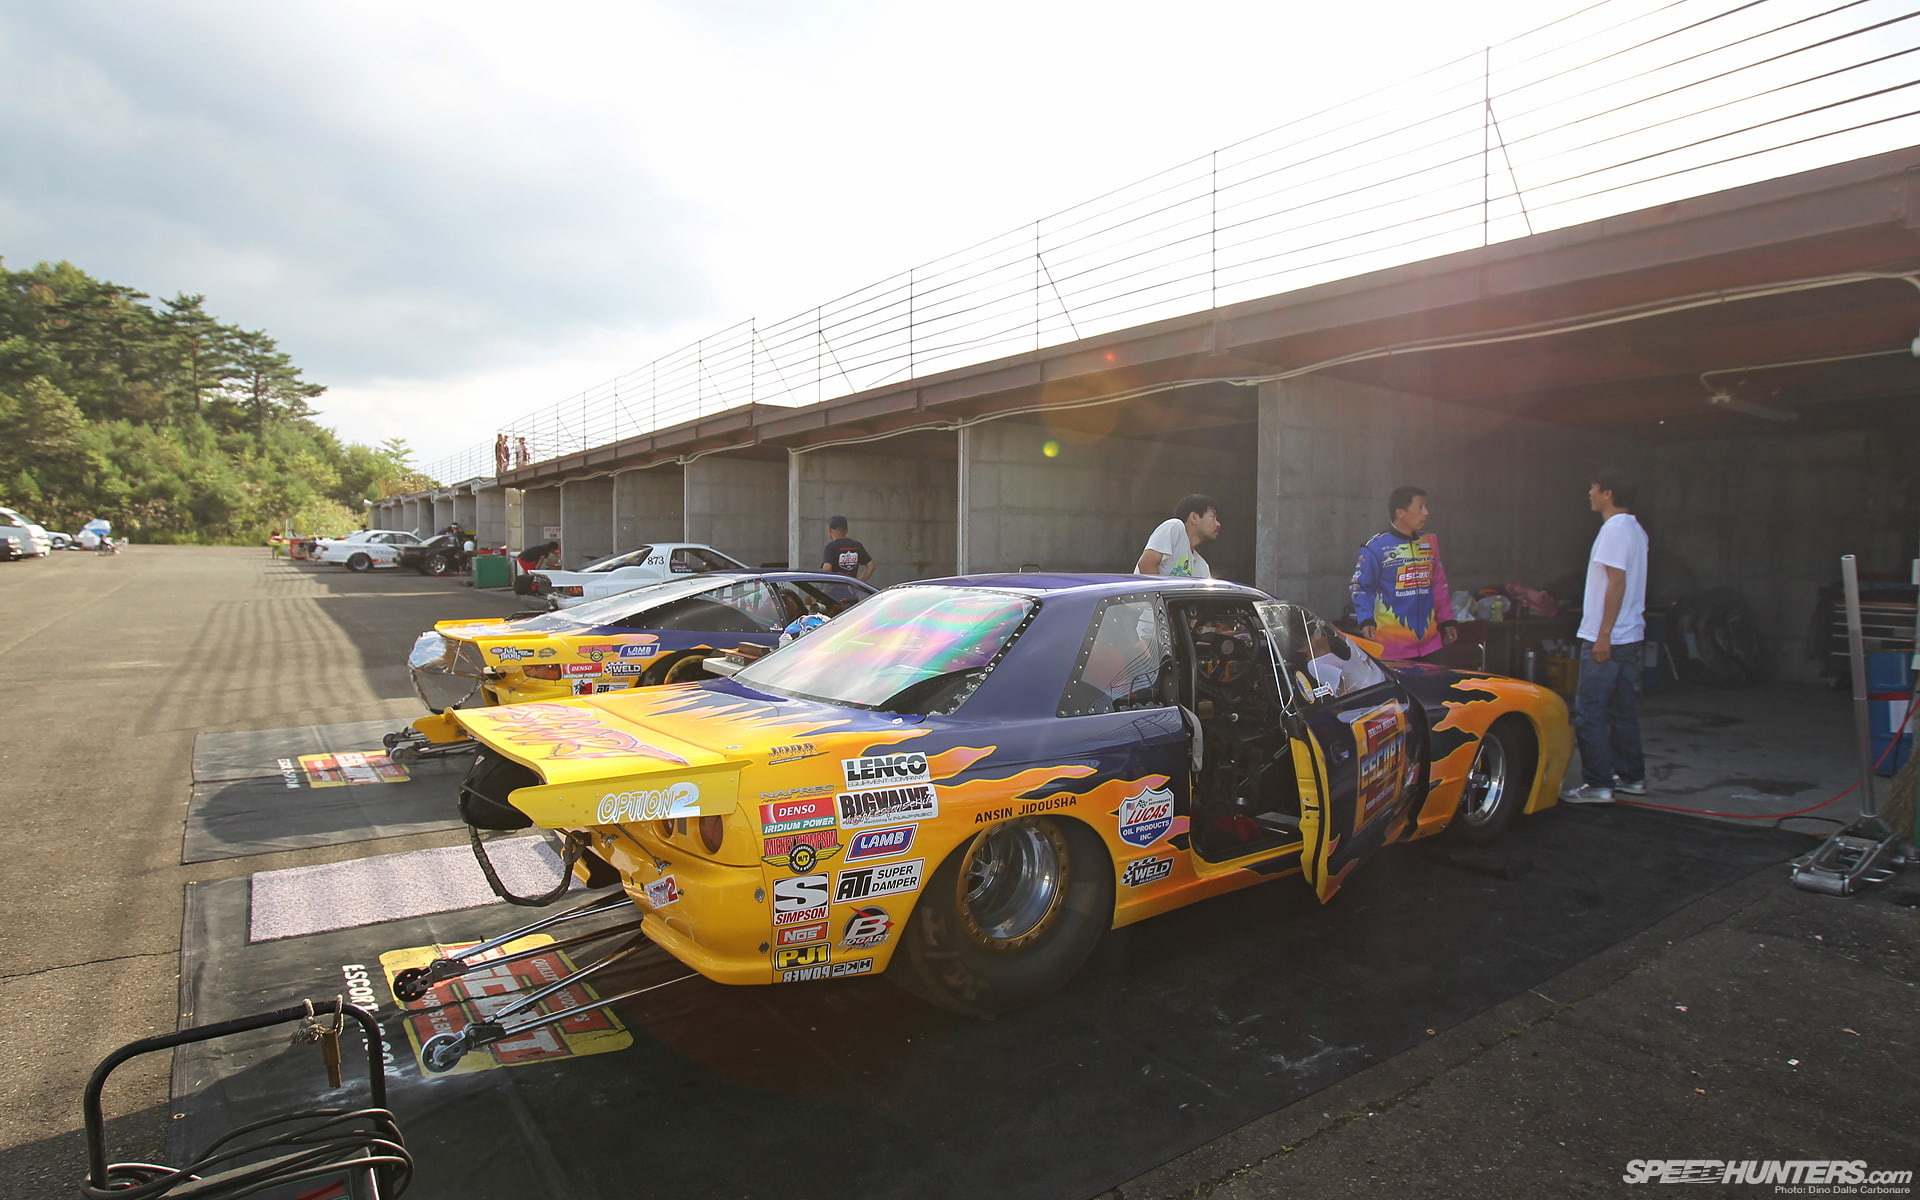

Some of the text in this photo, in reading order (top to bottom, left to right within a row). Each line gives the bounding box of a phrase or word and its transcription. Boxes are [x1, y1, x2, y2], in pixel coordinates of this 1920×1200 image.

[647, 556, 665, 566] 873
[612, 665, 641, 673] WELD
[847, 754, 927, 782] LENCO
[890, 774, 925, 785] COMPANY
[760, 784, 834, 799] NAPREC
[778, 804, 816, 817] DENSO
[839, 786, 933, 819] BIGVALVE
[974, 796, 1078, 824] ANSIN JIDOUSHA
[1126, 803, 1170, 825] LUCAS
[764, 817, 835, 834] IRIDIUM POWER
[1122, 820, 1170, 837] OIL PRODUCTS
[765, 836, 794, 856] MICKEY
[795, 831, 837, 850] THOMPSON
[860, 831, 905, 849] LAMB
[877, 865, 914, 880] SUPER
[1134, 862, 1170, 881] WELD
[836, 869, 874, 901] ATI
[871, 876, 918, 893] DAMPER
[775, 906, 827, 925] SIMPSON
[784, 928, 819, 943] NOS
[778, 944, 828, 968] PJ1
